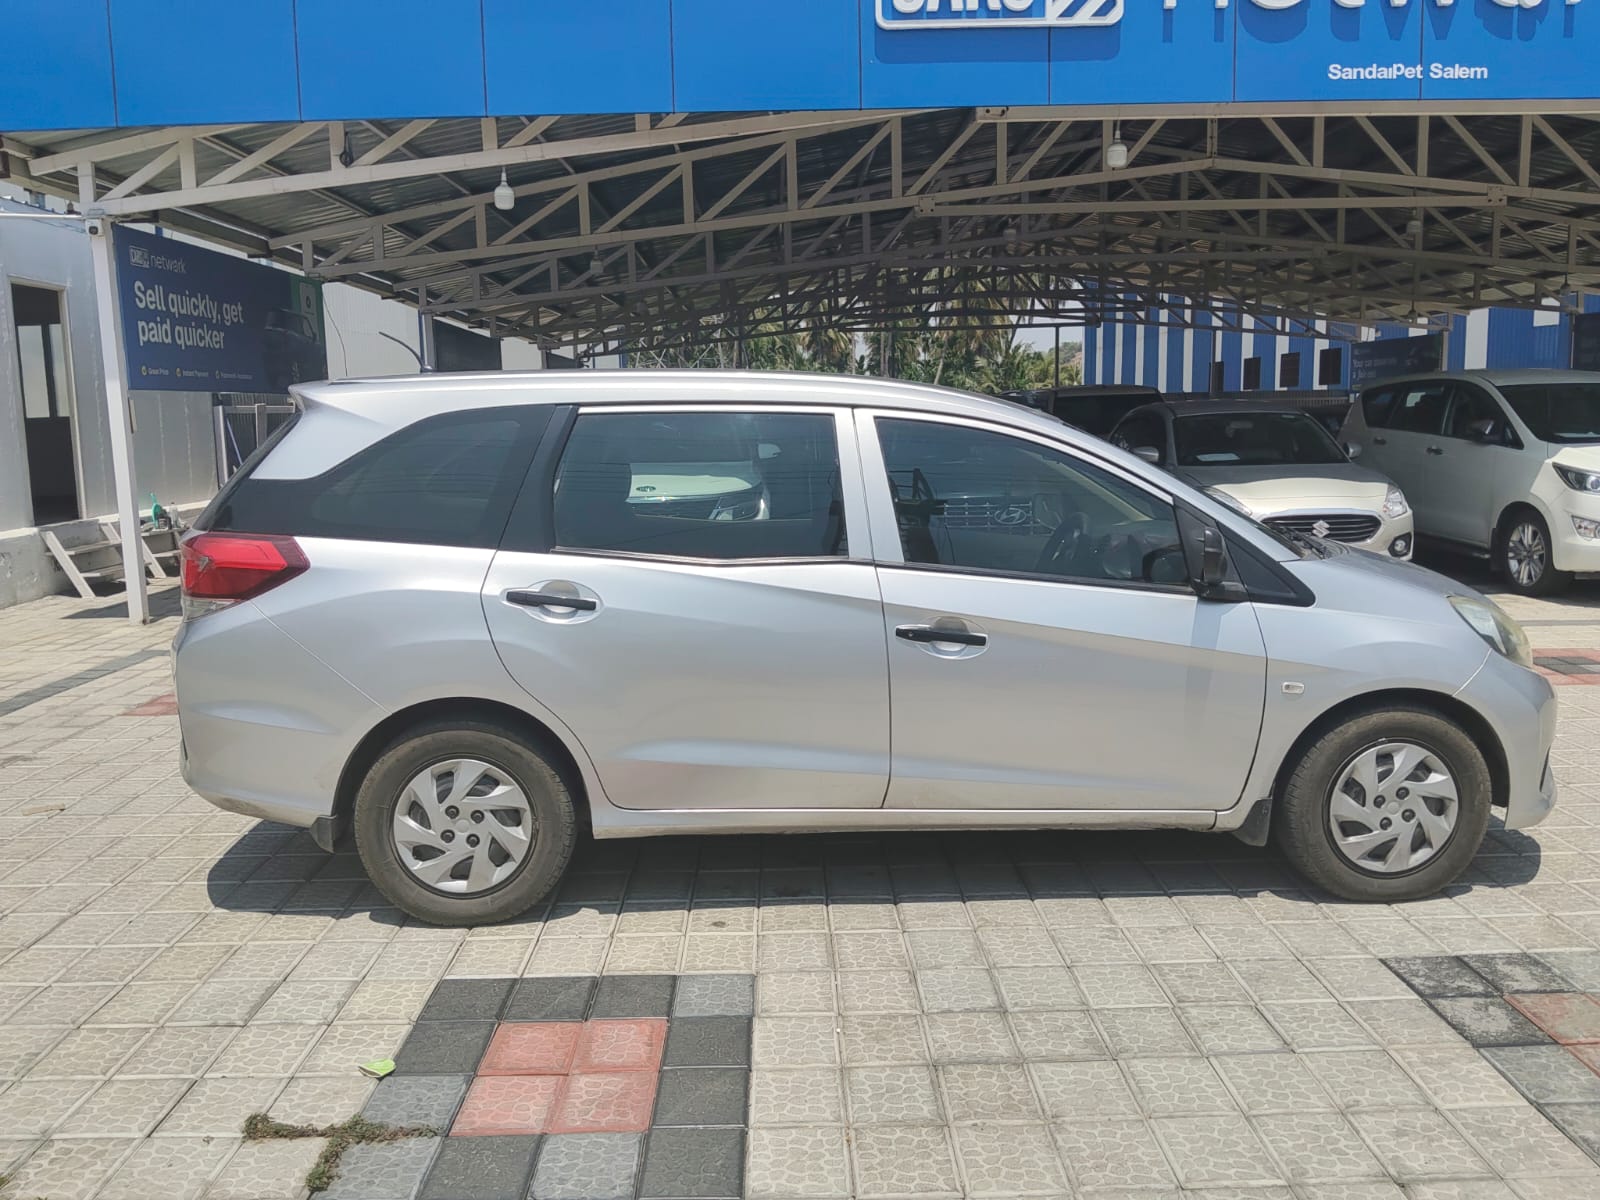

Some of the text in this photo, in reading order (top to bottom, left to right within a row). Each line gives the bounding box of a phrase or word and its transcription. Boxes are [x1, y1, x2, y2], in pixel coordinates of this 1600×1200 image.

[1429, 63, 1488, 79] Salem
[134, 280, 244, 326] Sell quickly, get
[137, 316, 225, 350] paid quicker
